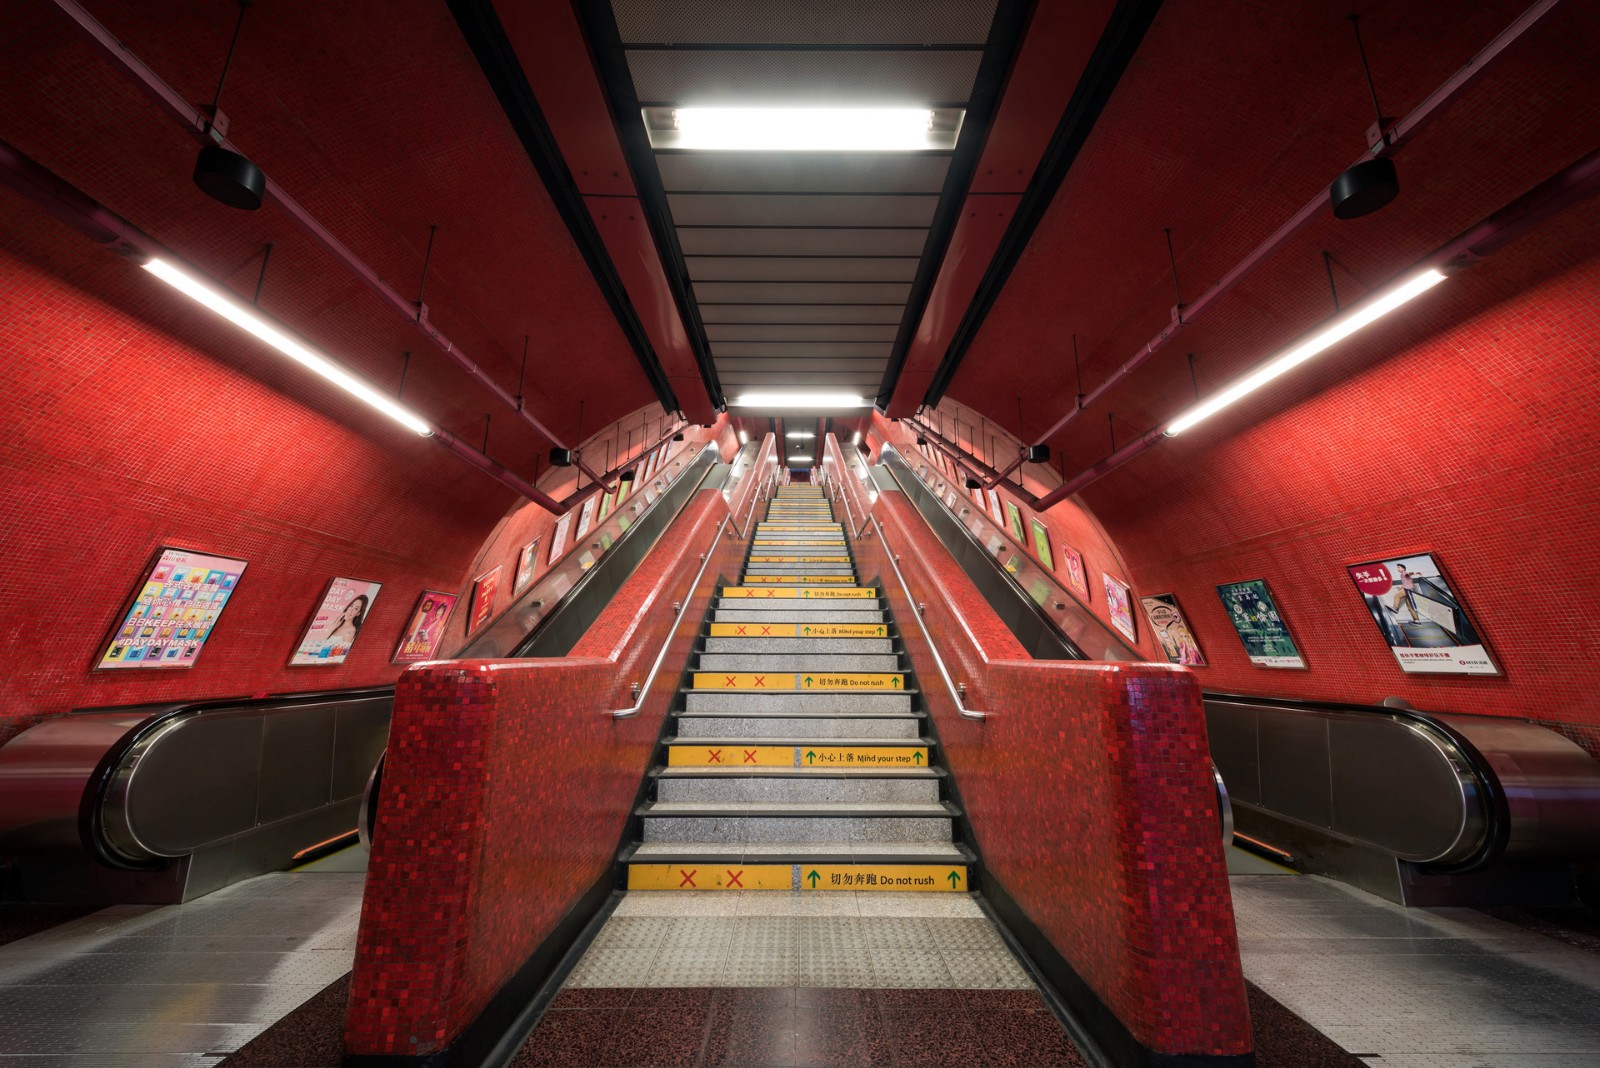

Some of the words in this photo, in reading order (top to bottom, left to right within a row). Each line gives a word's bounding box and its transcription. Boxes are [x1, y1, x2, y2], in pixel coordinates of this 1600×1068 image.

[329, 587, 346, 595] DAY
[325, 595, 343, 604] DAY
[117, 638, 200, 648] #DAYDAYMASK
[819, 677, 849, 686] 切勿奔跑
[818, 752, 855, 763] 小心上落
[857, 754, 876, 763] Mind
[877, 756, 894, 764] your
[895, 755, 912, 764] step
[831, 872, 878, 886] 切勿奔跑
[880, 875, 894, 886] Do
[896, 876, 912, 885] not
[914, 875, 935, 885] rush
